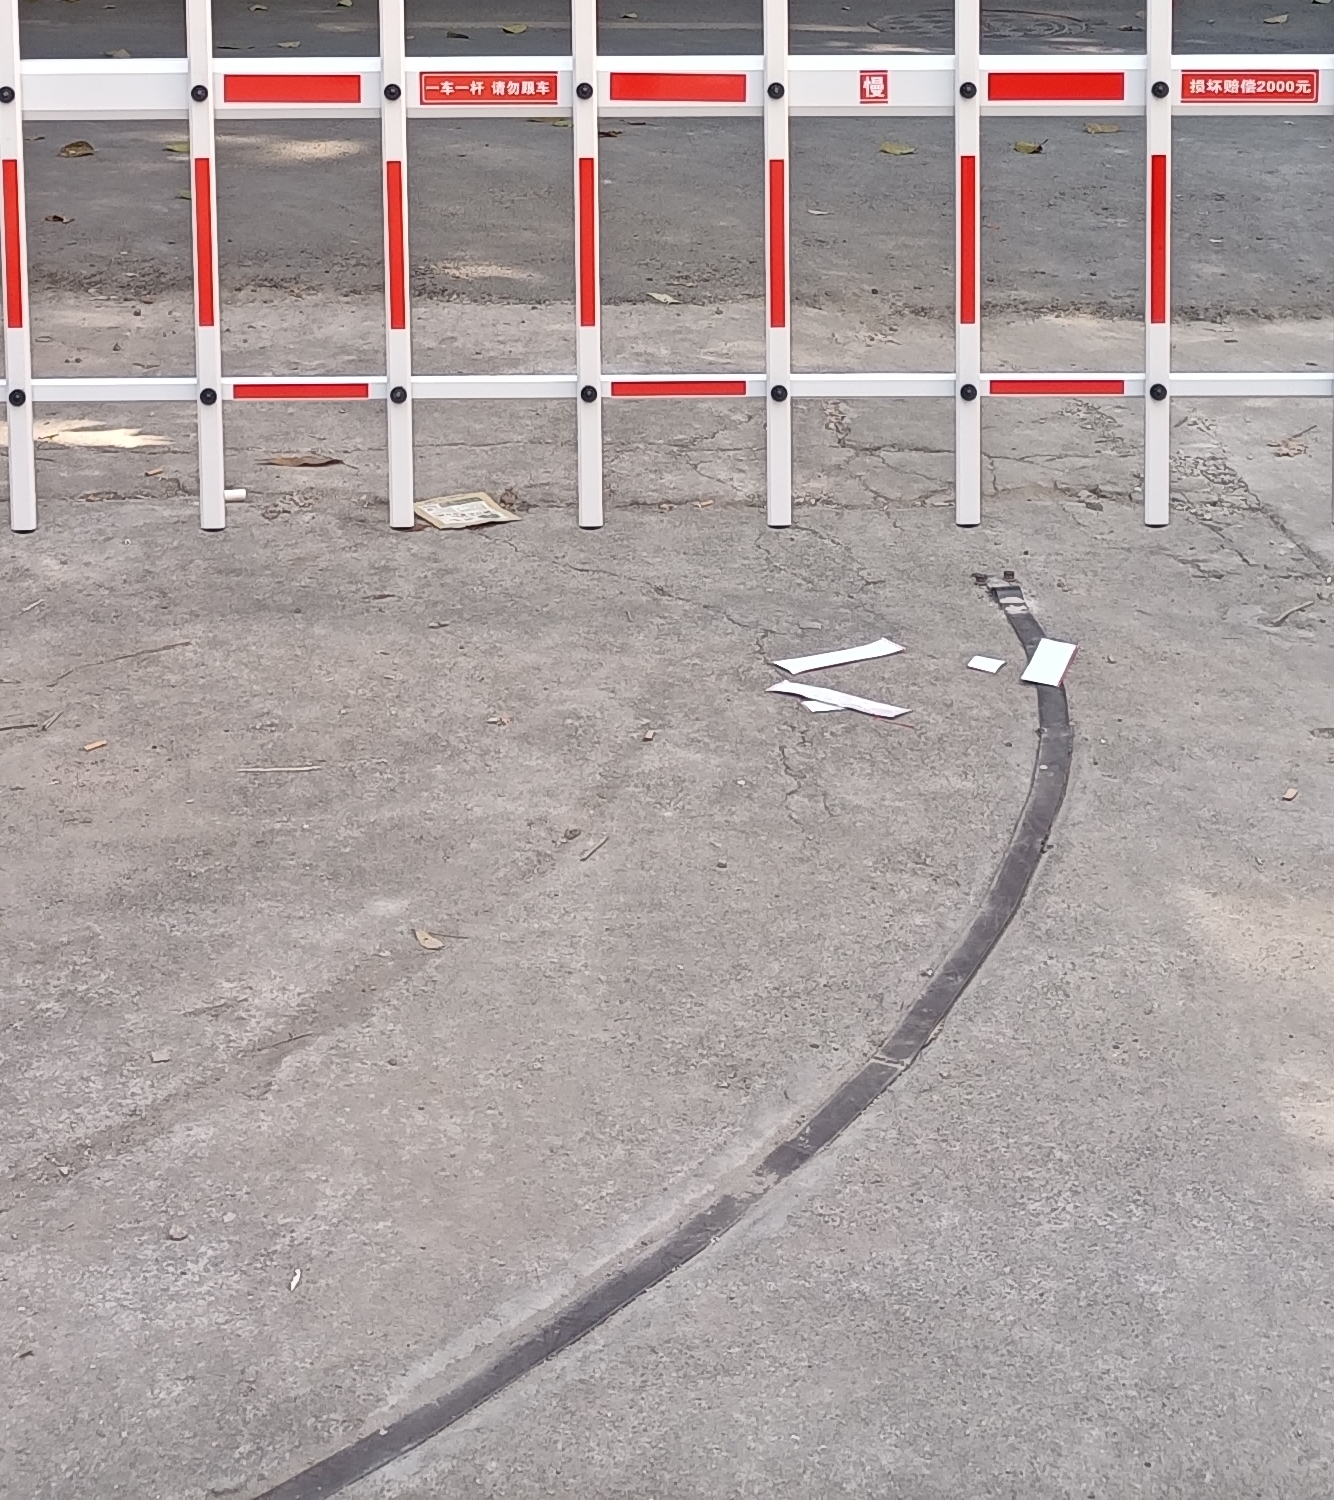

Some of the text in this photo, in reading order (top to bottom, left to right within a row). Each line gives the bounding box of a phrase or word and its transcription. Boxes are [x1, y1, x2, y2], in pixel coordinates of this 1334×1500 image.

[425, 80, 551, 96] 一车一杆 请勿跟车
[862, 75, 886, 98] 慢
[1189, 78, 1313, 95] 损坏赔偿2000元
